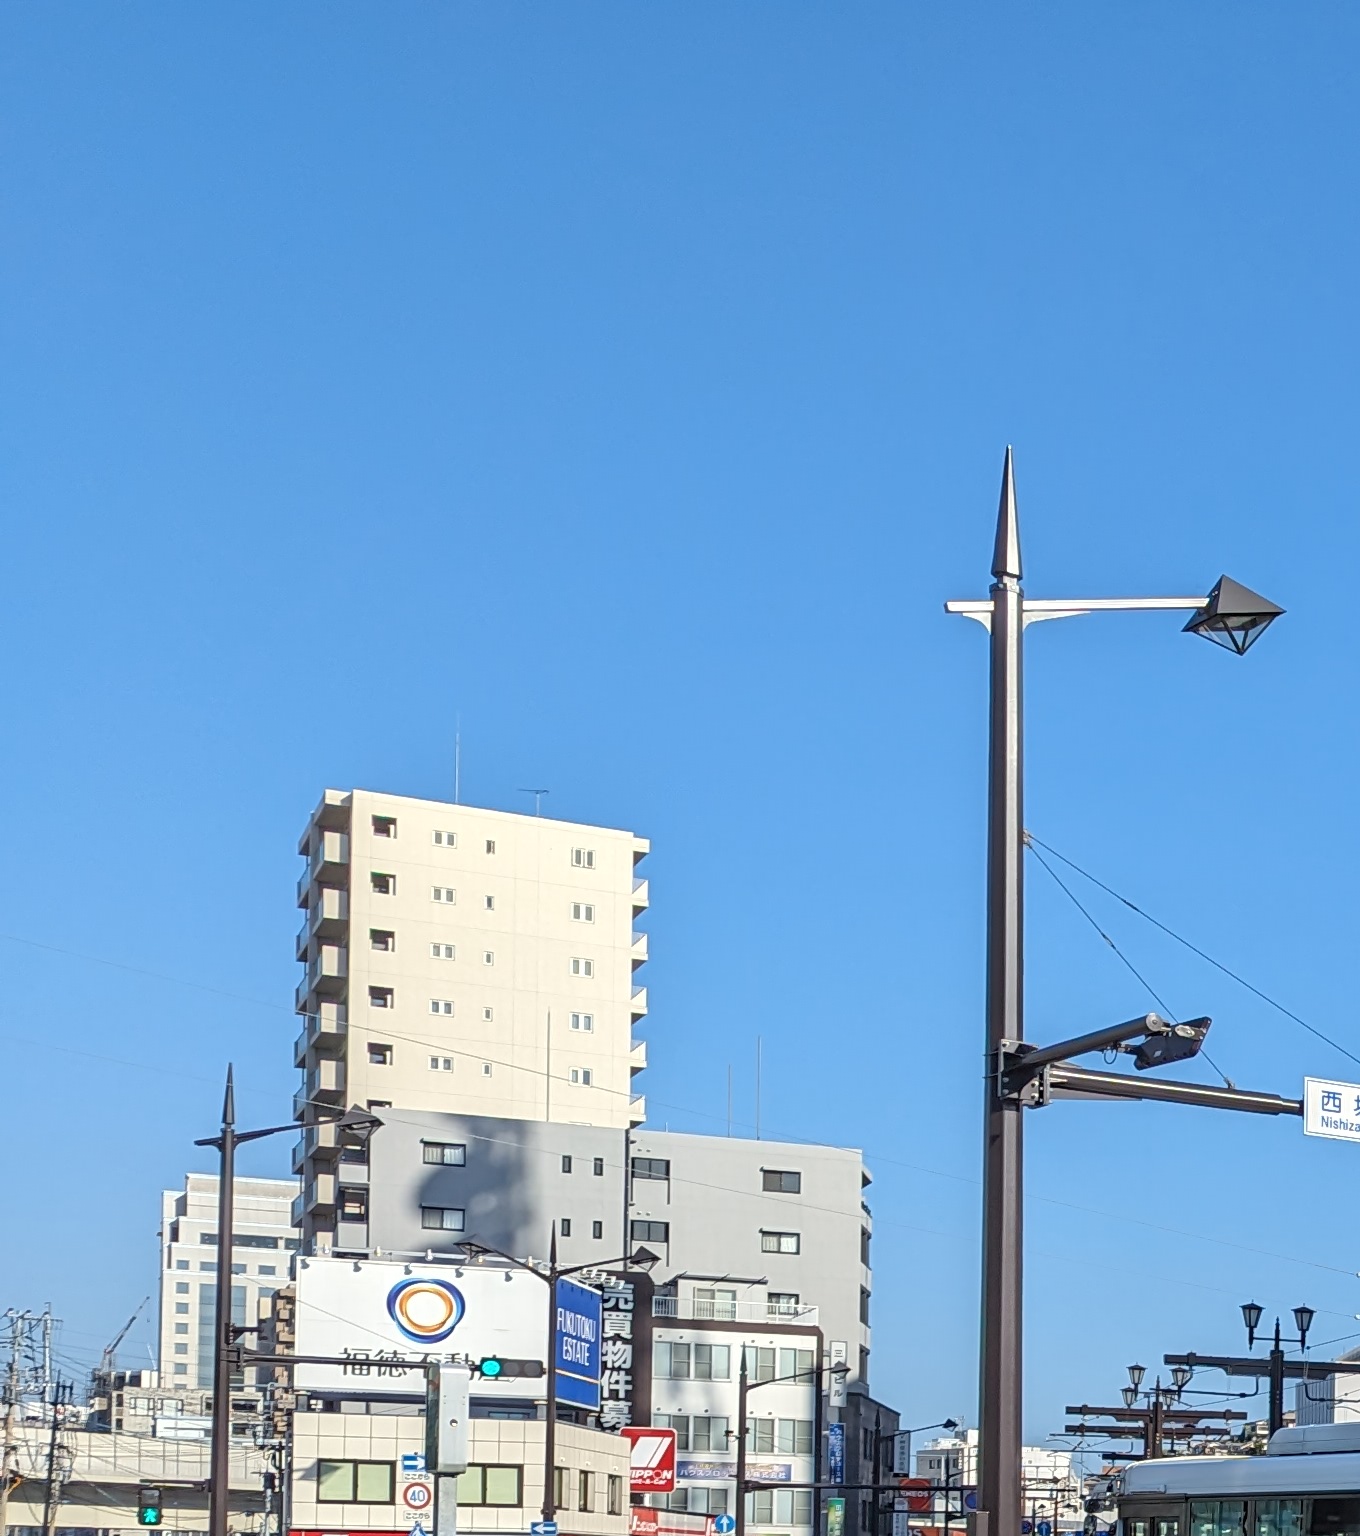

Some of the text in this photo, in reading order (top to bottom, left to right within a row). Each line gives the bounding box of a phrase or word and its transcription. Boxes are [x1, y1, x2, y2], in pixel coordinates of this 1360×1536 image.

[557, 1307, 596, 1342] FUKUTOKU
[562, 1336, 590, 1366] ESTATE
[600, 1282, 634, 1434] 売買物件募
[833, 1349, 844, 1398] 三ビル
[404, 1473, 430, 1481] ここから
[410, 1490, 426, 1502] 40
[901, 1490, 929, 1499] ENEOS
[405, 1512, 430, 1520] ここから
